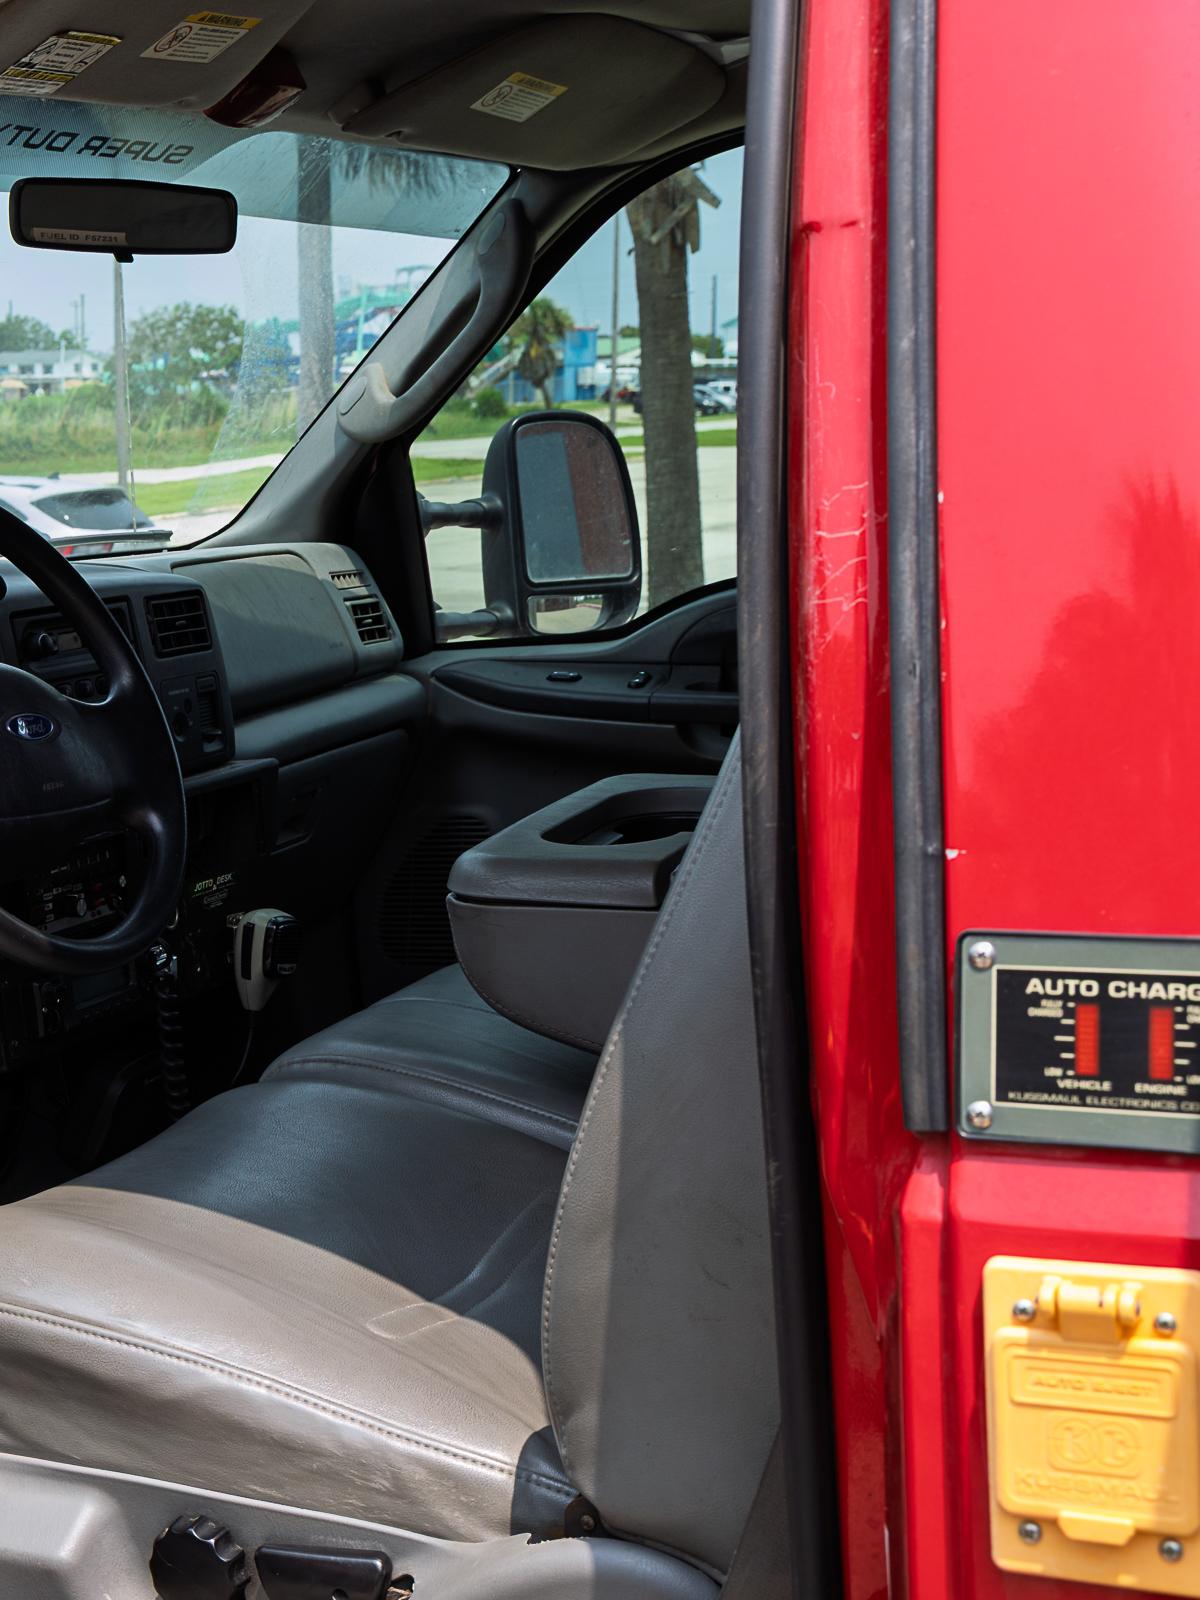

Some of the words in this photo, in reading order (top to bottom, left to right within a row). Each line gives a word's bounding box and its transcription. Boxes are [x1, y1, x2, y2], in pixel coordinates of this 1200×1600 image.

[40, 232, 65, 240] FUEL
[69, 233, 79, 241] ID
[1025, 978, 1100, 997] AUTO
[1055, 1078, 1113, 1093] VEHICLE
[1134, 1082, 1189, 1097] ENGINE
[1007, 1091, 1081, 1105] KUSSMAUL
[1085, 1096, 1179, 1111] ELECTRONICS
